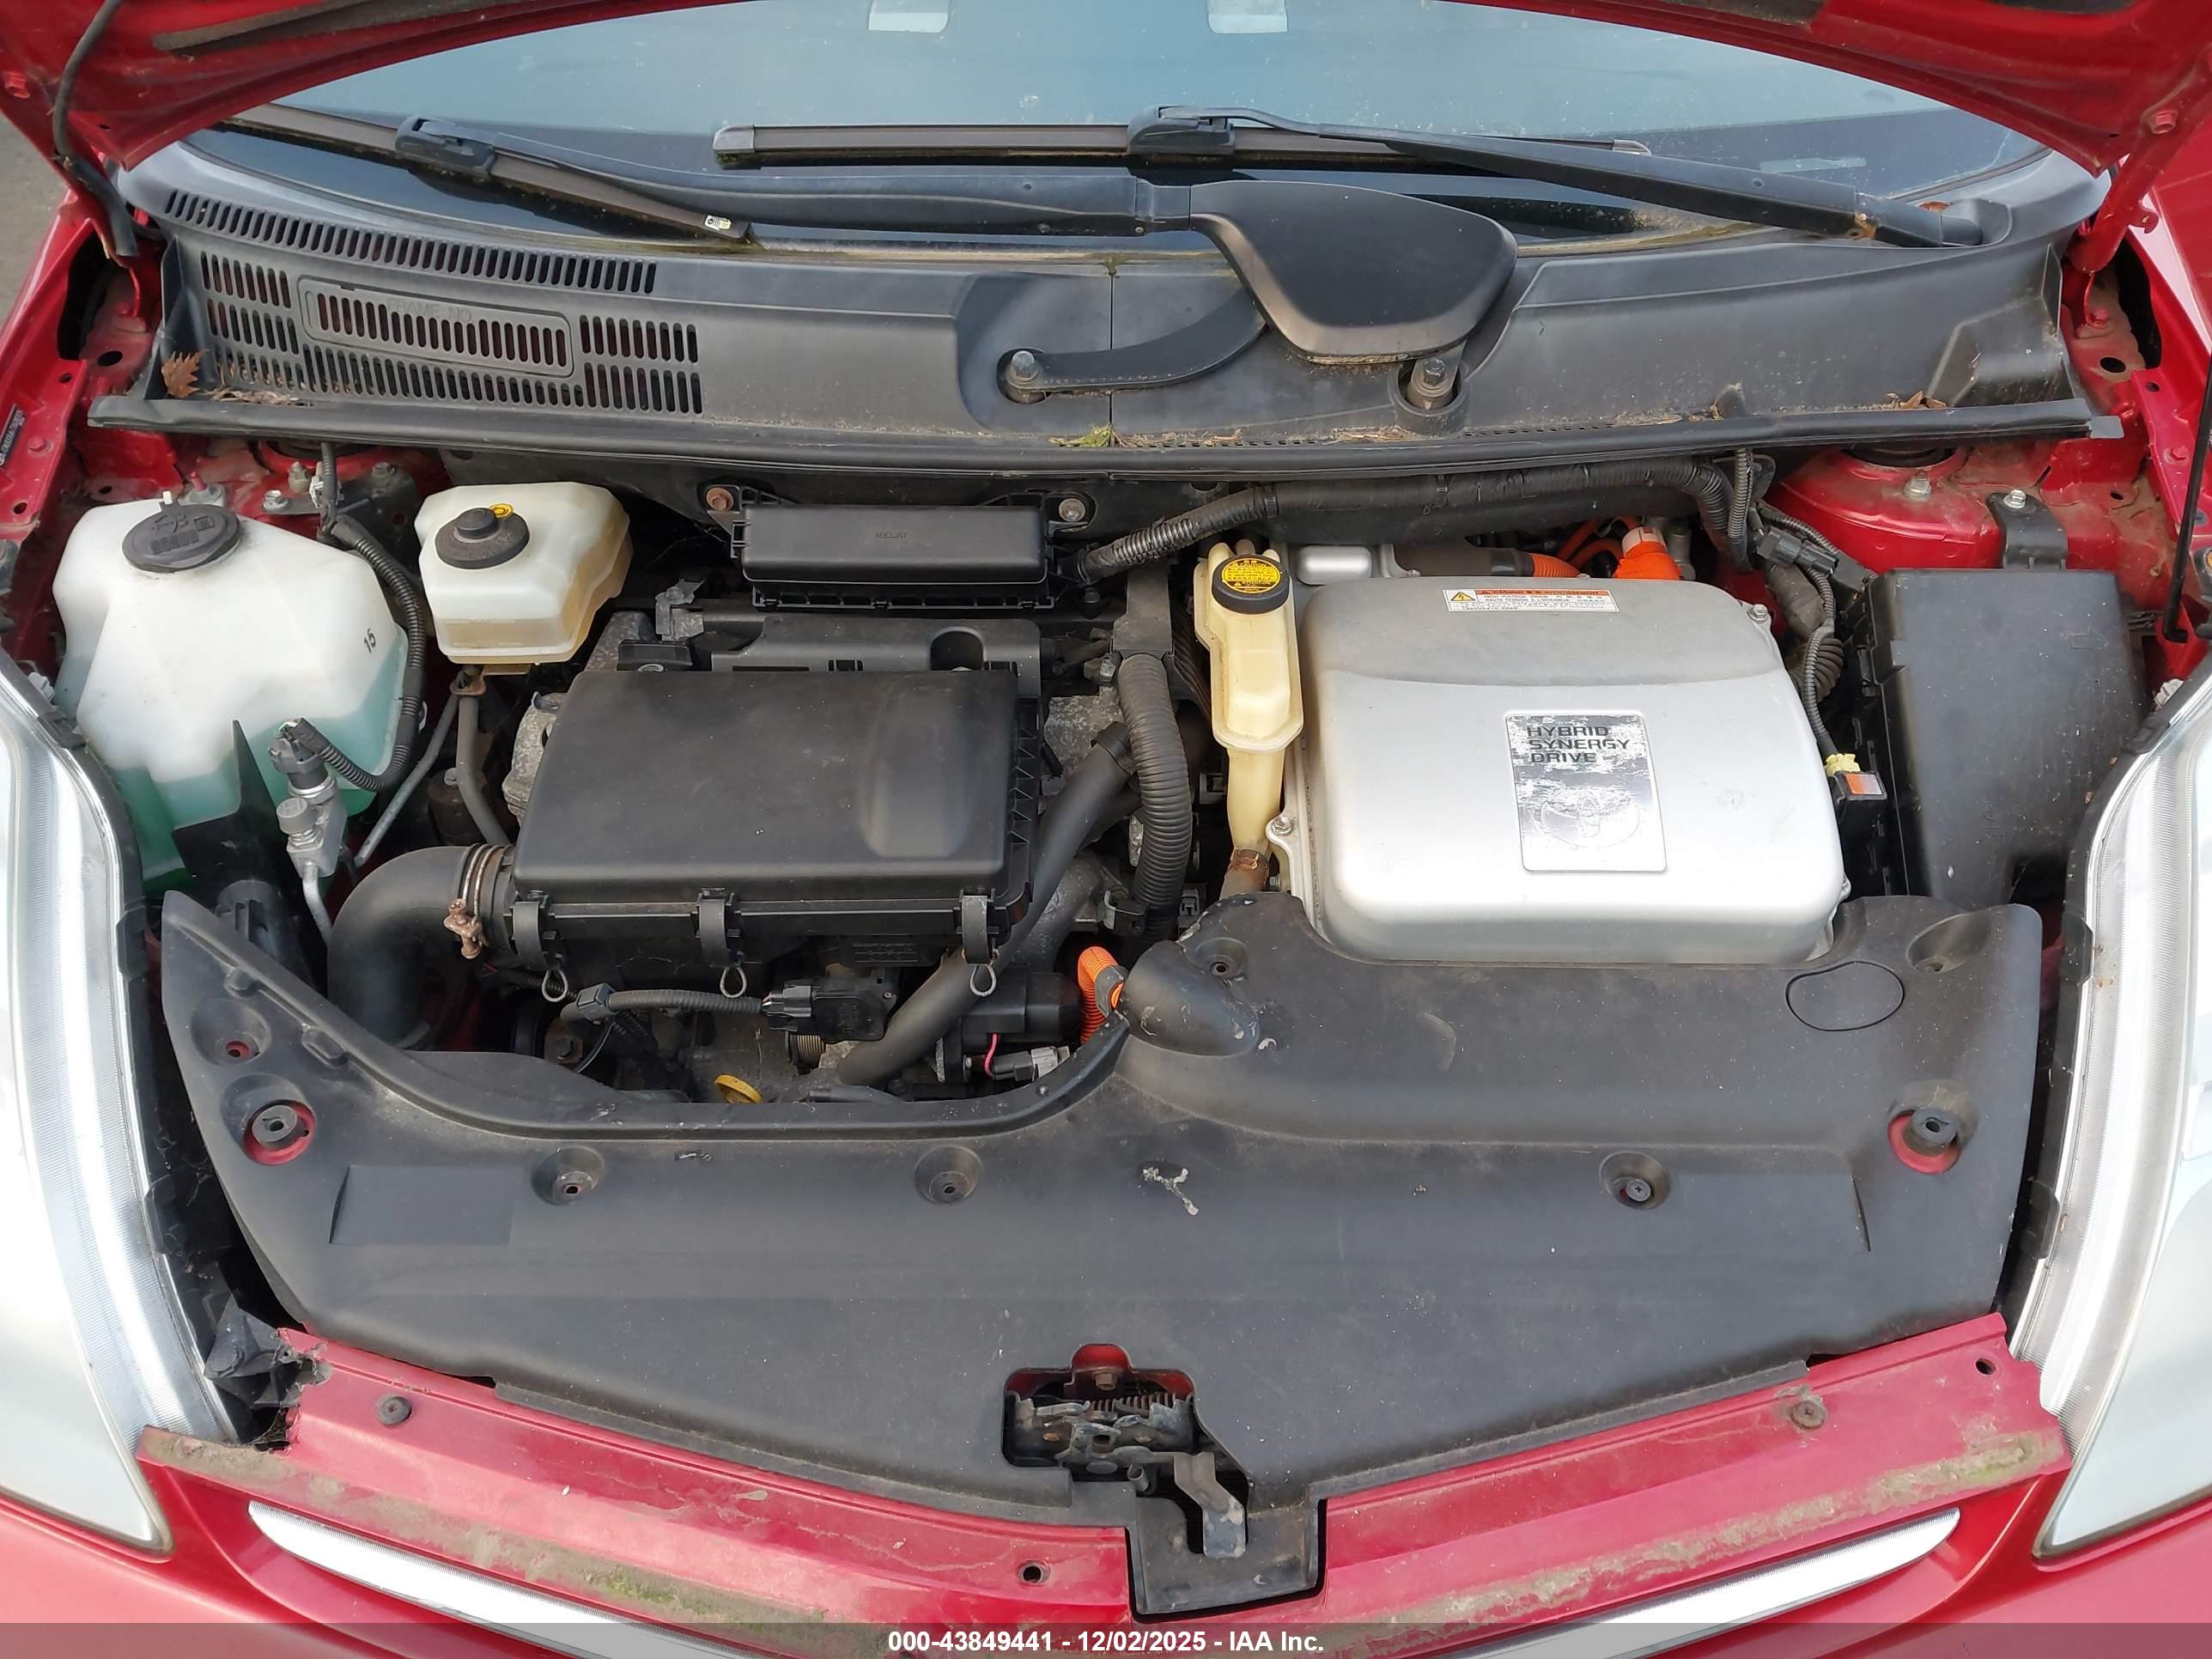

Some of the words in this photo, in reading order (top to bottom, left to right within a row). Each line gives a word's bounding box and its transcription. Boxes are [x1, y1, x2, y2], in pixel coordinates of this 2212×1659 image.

[1527, 726, 1609, 737] HYBRID
[1528, 738, 1630, 750] SYNERGY
[1531, 752, 1596, 763] DRIVE
